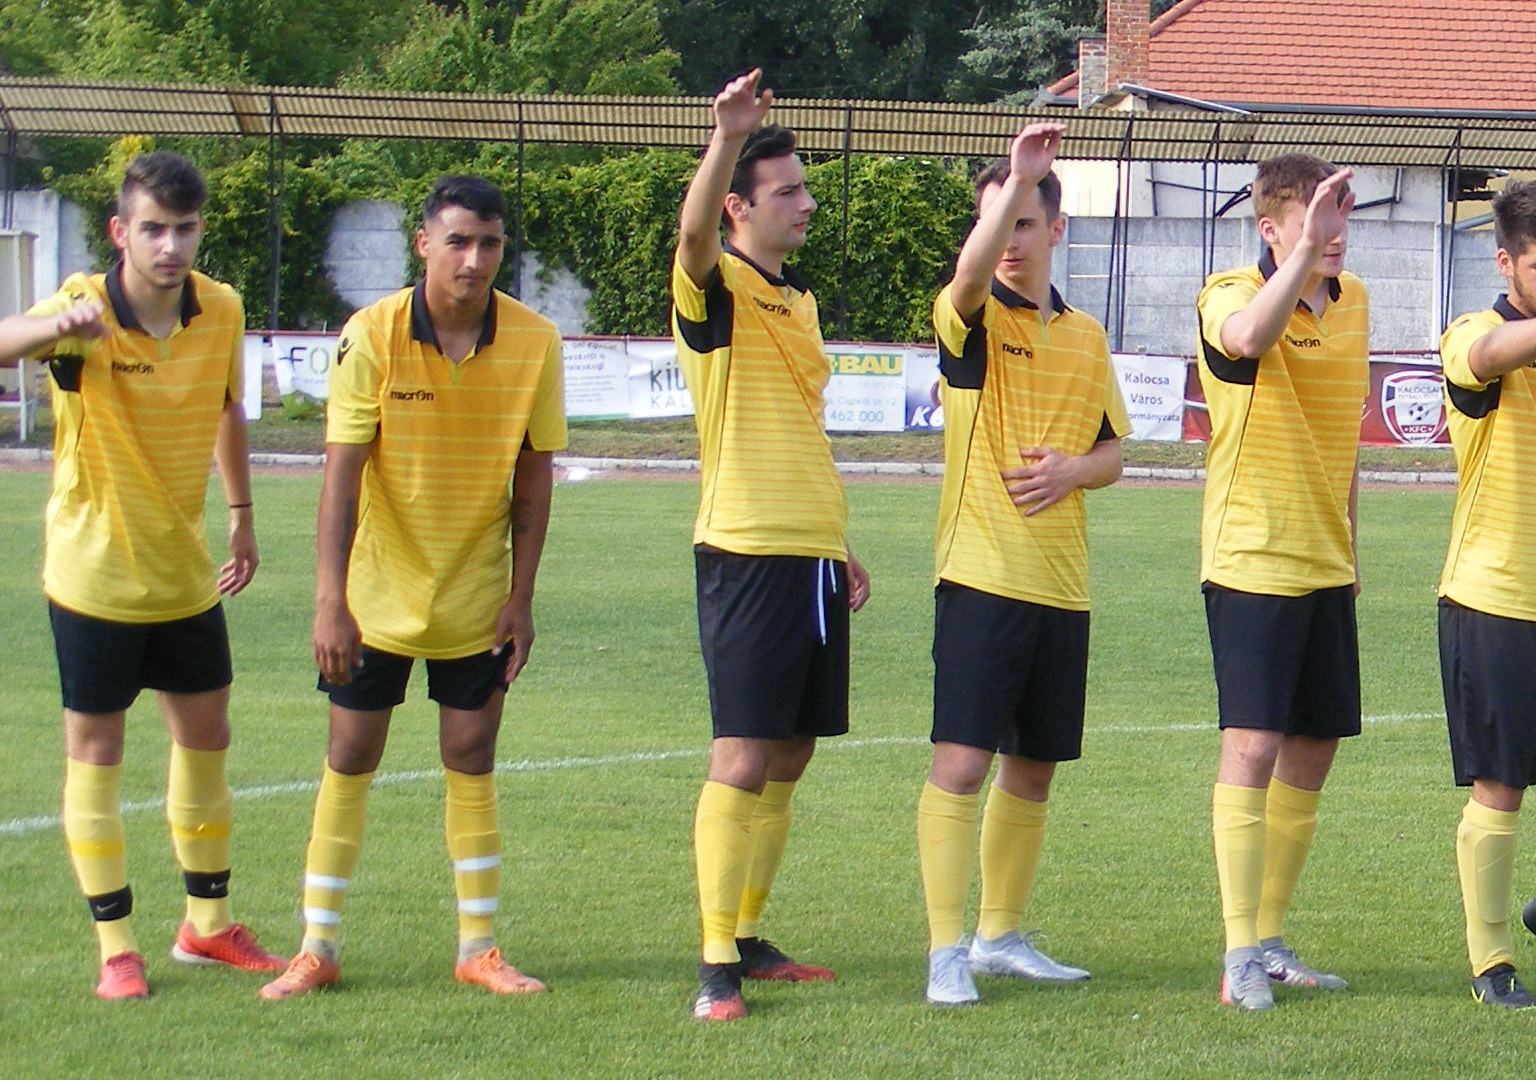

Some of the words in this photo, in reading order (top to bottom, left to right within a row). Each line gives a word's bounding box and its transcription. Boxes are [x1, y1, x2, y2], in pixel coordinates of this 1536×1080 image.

[753, 297, 791, 317] macron
[1285, 335, 1321, 348] macron
[1125, 373, 1170, 385] Kalocsa
[390, 390, 434, 400] macron
[1131, 393, 1163, 405] Város
[831, 410, 854, 421] 462
[859, 411, 884, 422] 000
[1409, 425, 1428, 433] KFC
